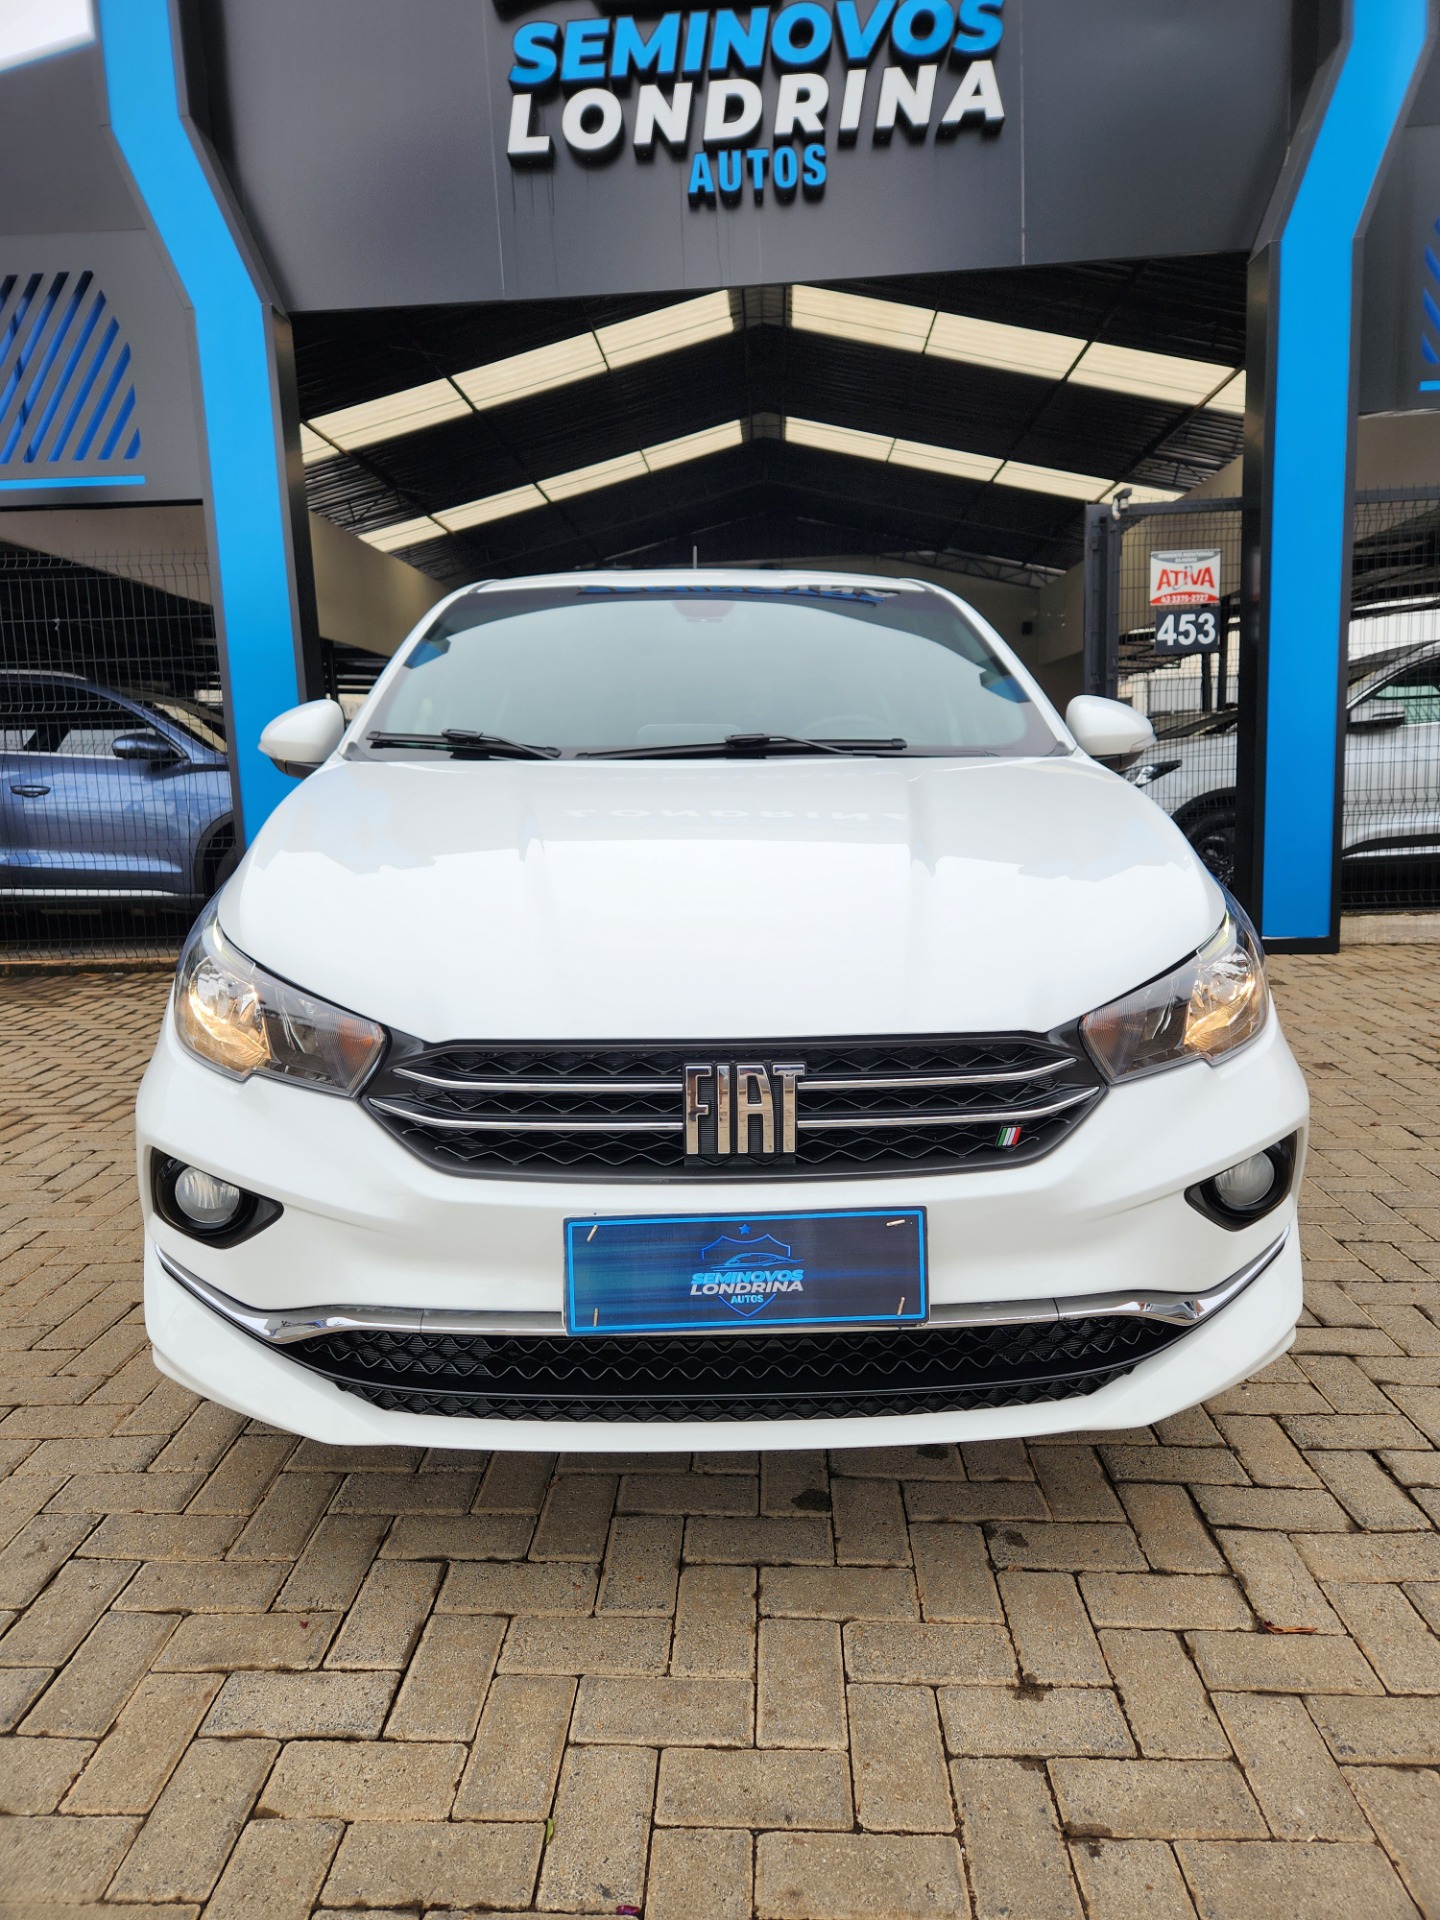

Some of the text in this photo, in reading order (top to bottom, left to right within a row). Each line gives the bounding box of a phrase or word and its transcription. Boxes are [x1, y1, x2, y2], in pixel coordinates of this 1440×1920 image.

[508, 0, 1005, 86] SEMINOVOS
[507, 60, 1005, 155] LONDRINA
[687, 143, 828, 194] AUTOS
[1156, 566, 1215, 591] ATIVA
[1161, 595, 1171, 604] 43
[1156, 612, 1217, 646] 453
[685, 1063, 807, 1154] FIAT
[690, 1280, 804, 1296] LONDRINA
[691, 1269, 805, 1285] SEMINOVOS
[730, 1294, 764, 1304] AUTOS
